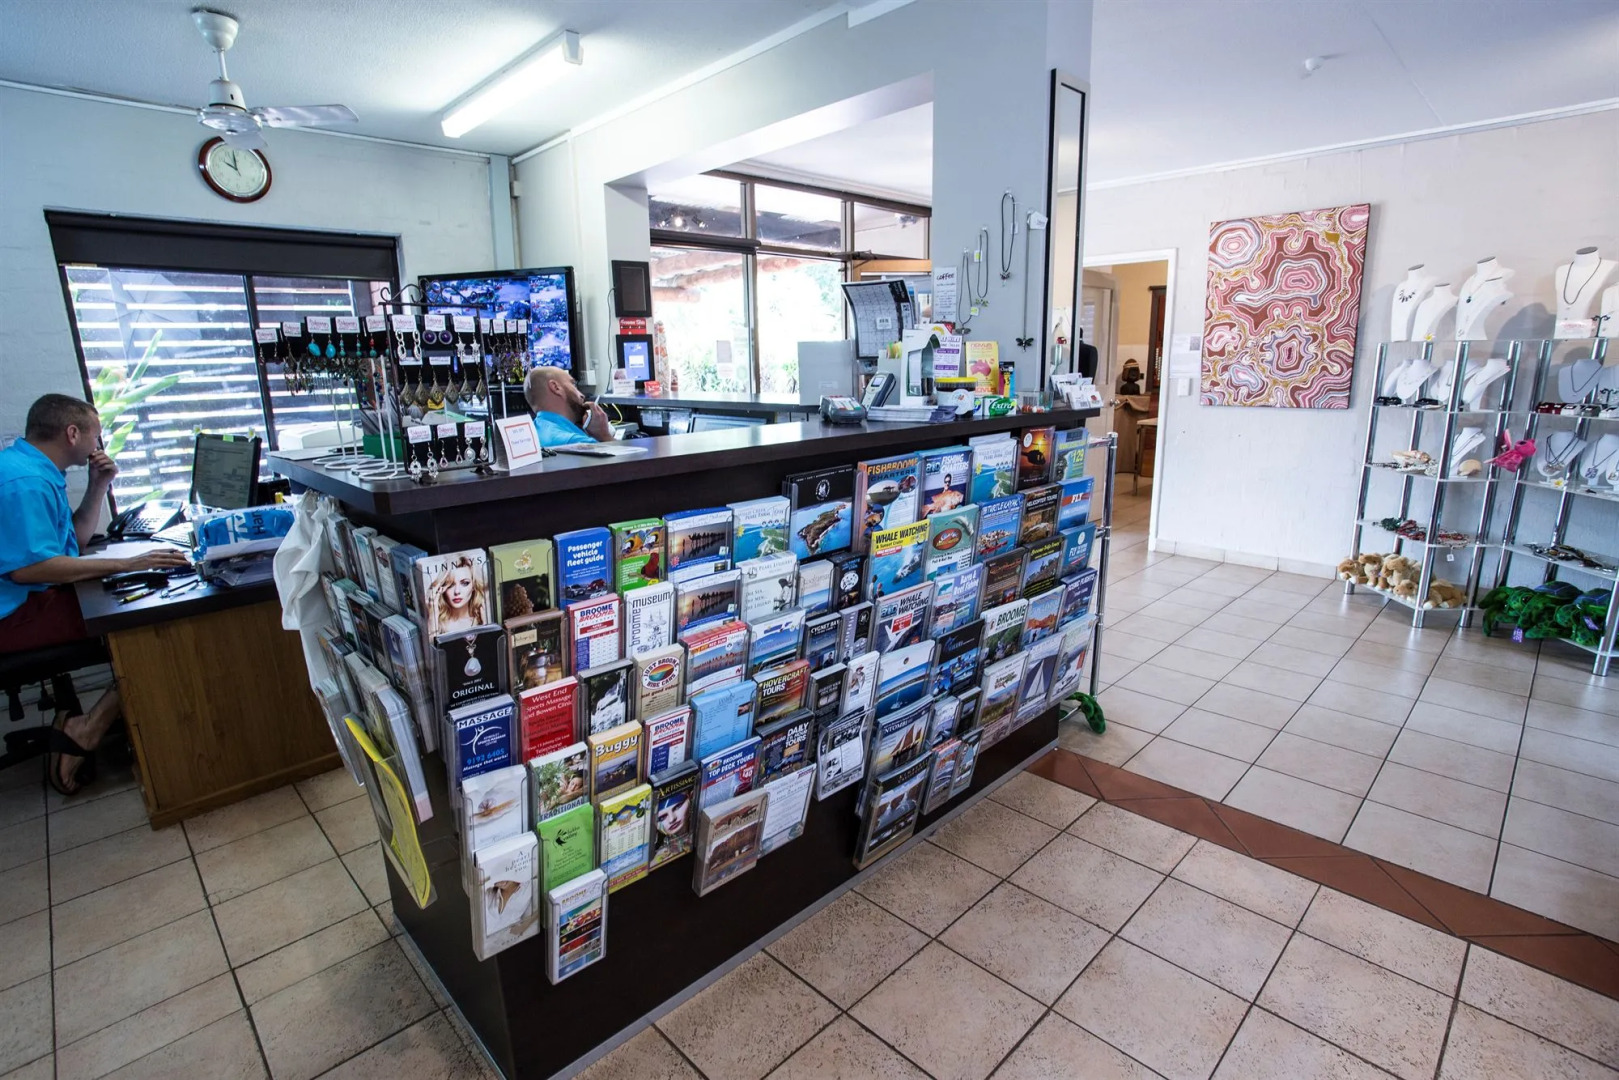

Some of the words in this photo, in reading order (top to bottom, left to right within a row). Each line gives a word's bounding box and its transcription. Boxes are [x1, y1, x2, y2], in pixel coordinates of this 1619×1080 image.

[991, 400, 1012, 409] Extra
[876, 531, 898, 544] WHALE
[899, 522, 929, 539] WATCHING
[567, 540, 603, 553] Passenger
[572, 549, 598, 558] vehicle
[426, 556, 482, 574] LINNYS
[567, 558, 582, 567] fleet
[584, 554, 604, 566] guide
[632, 591, 670, 608] museum
[898, 598, 930, 614] WATCHING
[900, 591, 922, 606] WHALE
[580, 603, 614, 616] BROOME
[632, 608, 641, 646] broome
[644, 662, 658, 676] JUST
[763, 666, 808, 689] HOVERCRAFT
[452, 682, 494, 698] ORIGINAL
[532, 690, 552, 702] West
[554, 687, 568, 698] End
[762, 682, 786, 696] TOURS
[526, 701, 545, 712] Sports
[546, 694, 572, 708] Massage
[458, 708, 511, 729] MASSAGE
[654, 716, 684, 732] BROOME
[787, 722, 810, 736] DAILY
[596, 736, 638, 757] Buggy
[785, 735, 806, 748] TOURS
[466, 752, 484, 765] 9192
[486, 748, 504, 759] 6405
[722, 752, 743, 766] BROOME
[462, 761, 482, 772] Massage
[483, 758, 493, 766] that
[708, 769, 720, 778] TOP
[720, 762, 736, 774] DECK
[736, 753, 754, 766] TOURS
